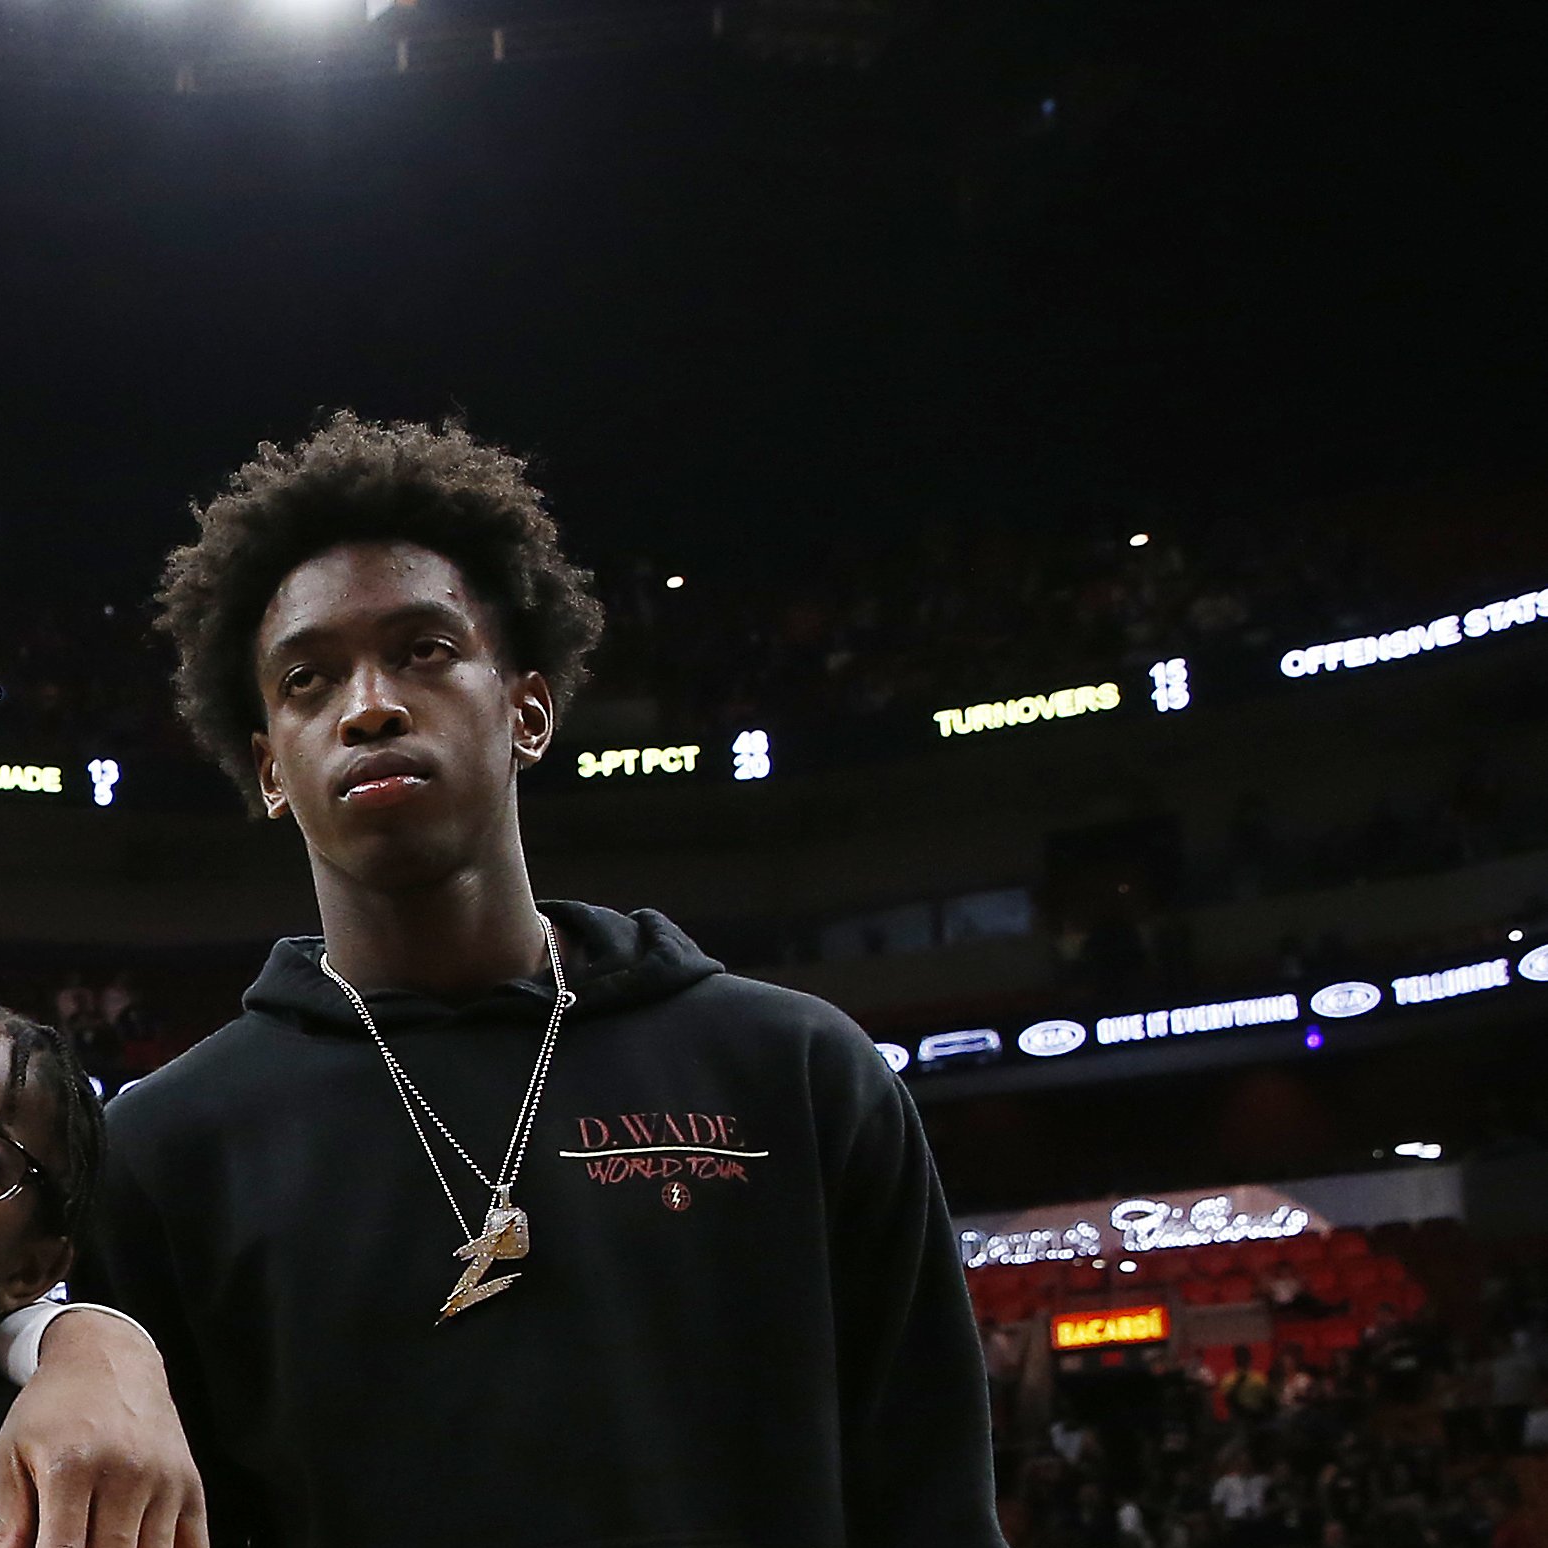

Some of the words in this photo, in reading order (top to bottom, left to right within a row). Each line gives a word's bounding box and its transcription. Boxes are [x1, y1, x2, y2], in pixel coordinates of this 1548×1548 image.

[1280, 615, 1463, 678] OFFENSIVE
[1149, 658, 1188, 689] 15
[932, 682, 1122, 738] TURNOVERS
[1151, 683, 1190, 713] 15
[87, 758, 120, 786] 13
[577, 748, 640, 778] 3-PT
[642, 744, 701, 774] PCT
[1391, 957, 1511, 1006] TELLURIDE
[1096, 1012, 1145, 1045] GIVE
[1170, 993, 1299, 1036] EVERYTHING
[587, 1155, 682, 1185] WORLD
[685, 1156, 749, 1183] TOUR
